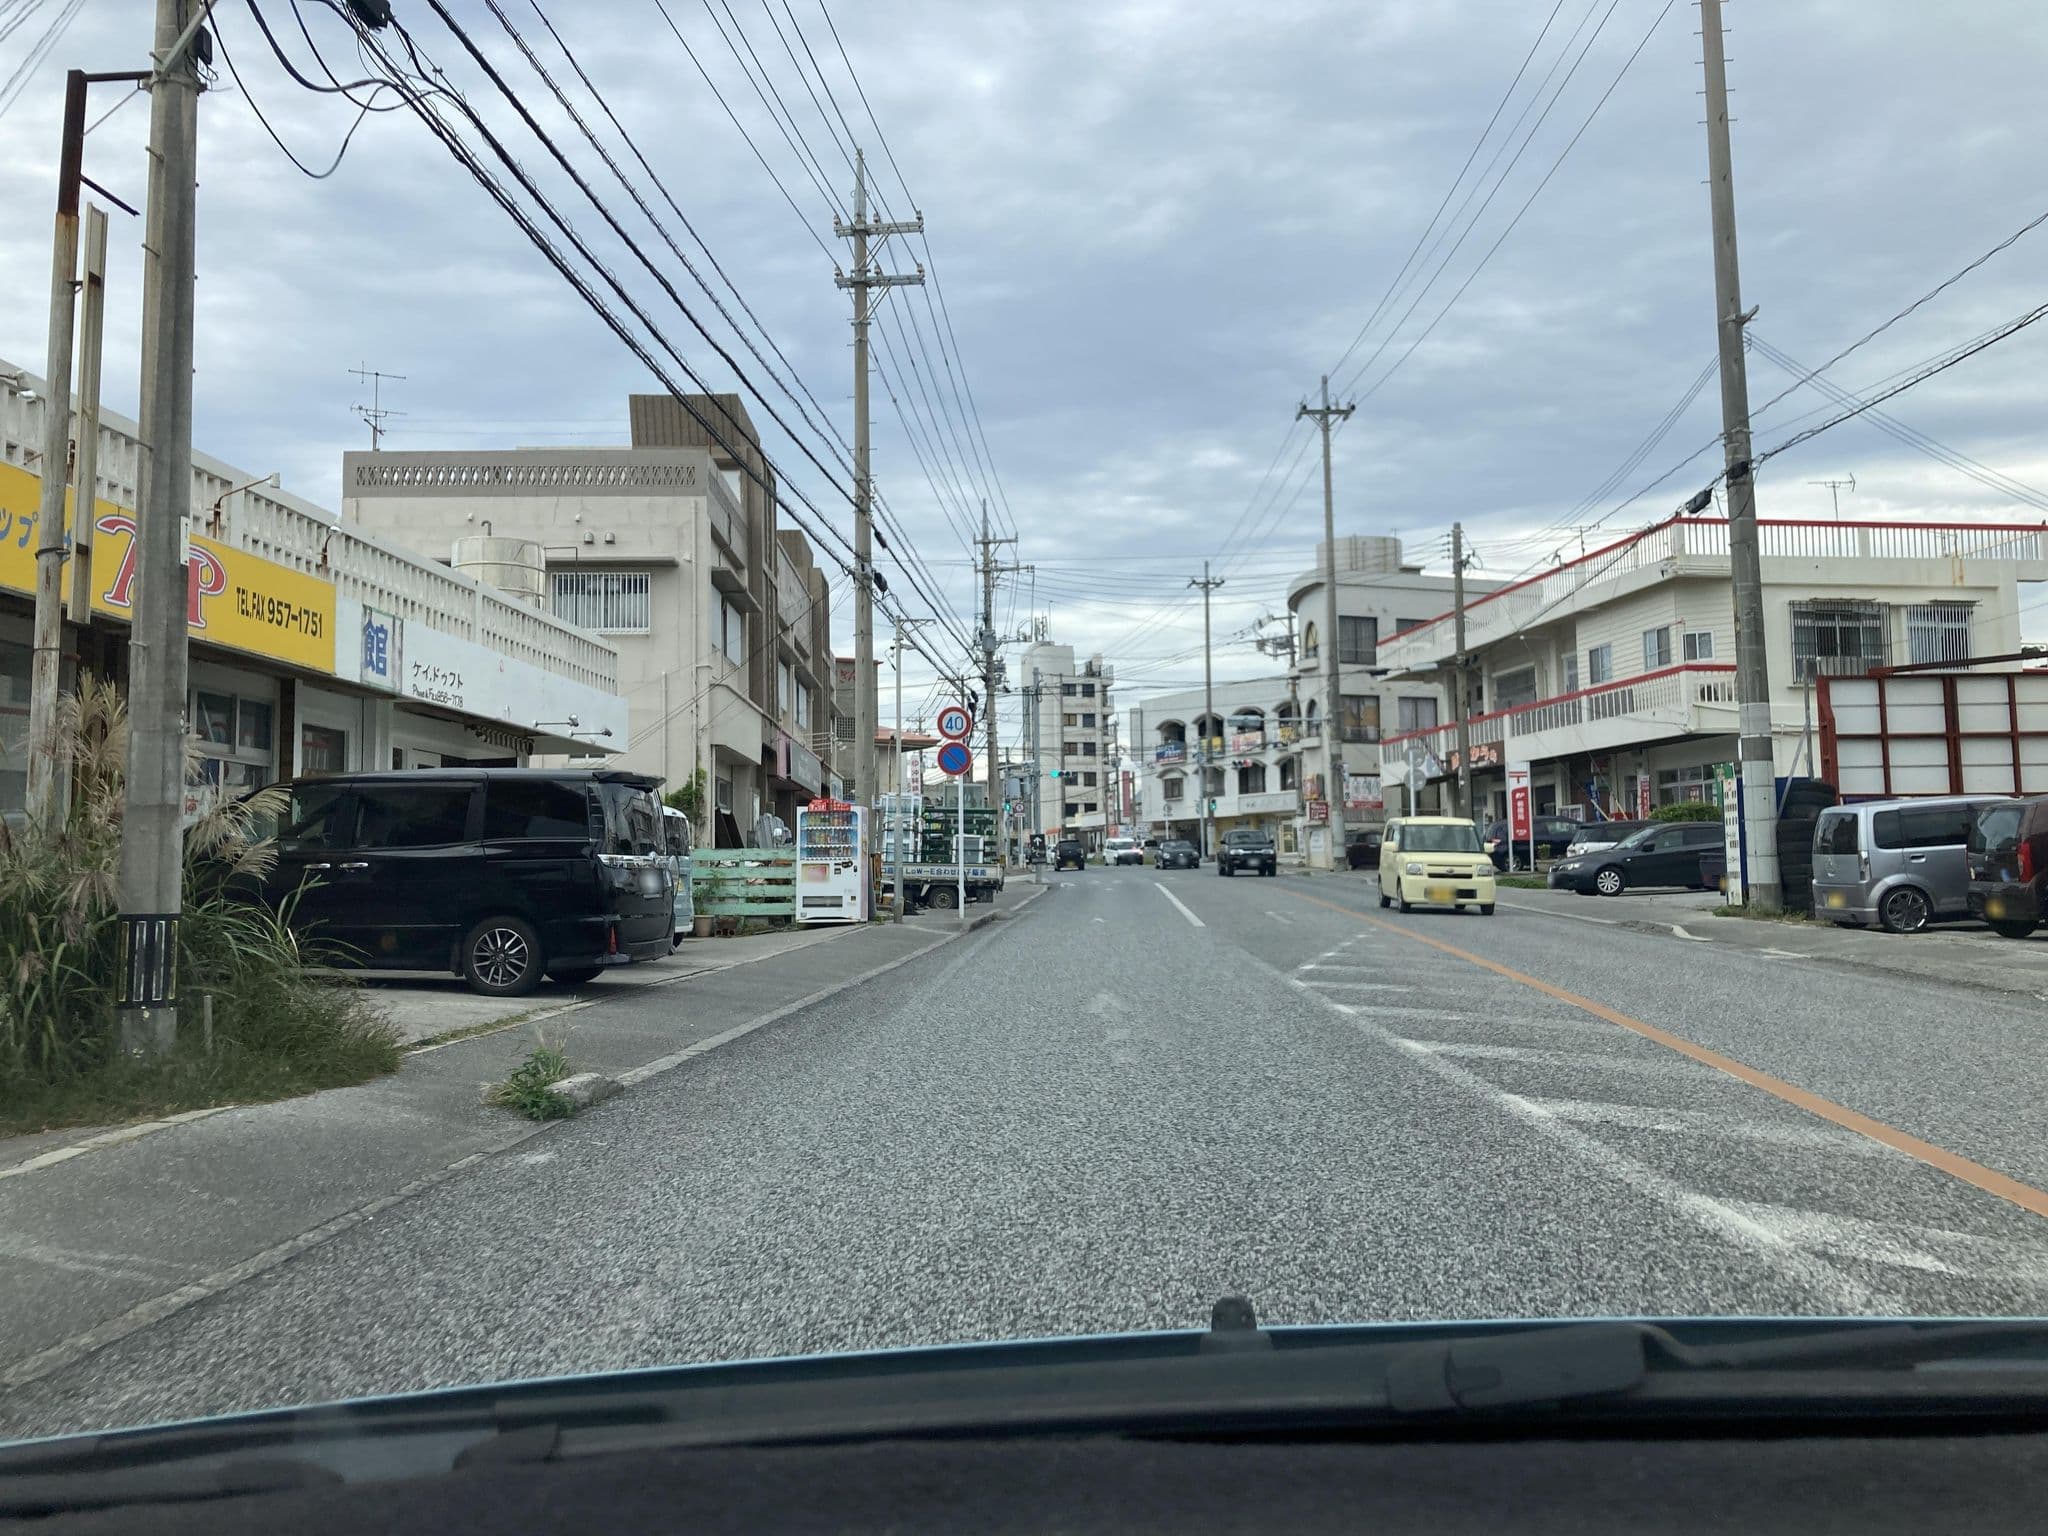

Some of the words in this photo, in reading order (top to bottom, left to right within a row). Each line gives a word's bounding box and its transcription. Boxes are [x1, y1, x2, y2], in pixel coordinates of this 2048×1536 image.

[267, 596, 323, 640] 957-1751
[363, 617, 389, 677] 館
[945, 715, 964, 732] 40
